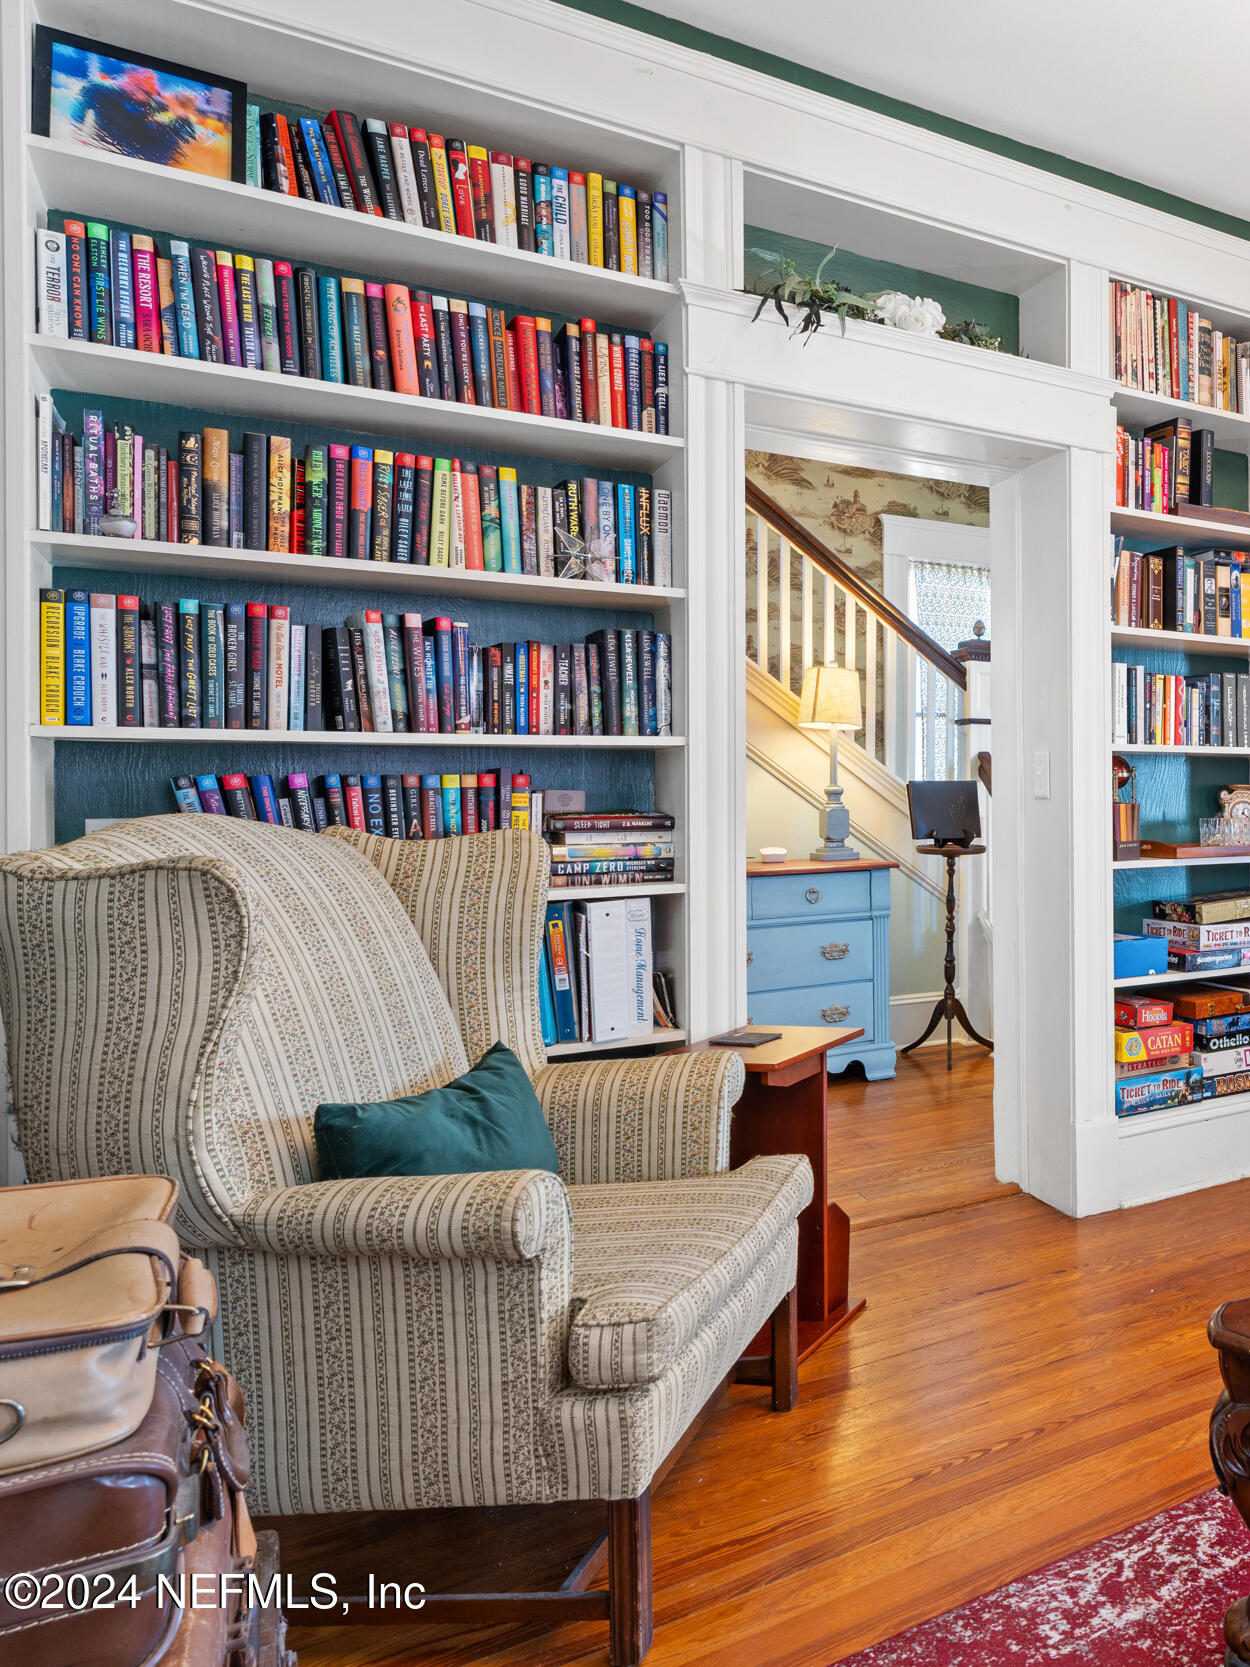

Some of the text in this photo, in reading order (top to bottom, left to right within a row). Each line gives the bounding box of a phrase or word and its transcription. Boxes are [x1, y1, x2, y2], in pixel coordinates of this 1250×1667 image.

[375, 136, 391, 180] JANE HARPER
[419, 168, 429, 193] Letters
[554, 195, 567, 225] CHILD
[99, 240, 107, 269] ASHLEY
[137, 253, 150, 271] THE
[71, 237, 83, 328] NO ONE CAN KNOW
[118, 253, 130, 290] HELSINKI
[177, 256, 189, 284] WHEN
[46, 266, 61, 302] TERROR
[138, 272, 153, 310] RESORT
[326, 283, 335, 300] THE
[96, 271, 106, 340] FIRST LIE WINS
[119, 291, 131, 319] AFFAIR
[240, 273, 253, 322] THE LAST WORD
[180, 303, 192, 329] DEAD
[327, 301, 337, 323] SONG
[493, 313, 502, 337] CIRCE
[244, 327, 255, 349] TAYLOR
[419, 313, 431, 357] LAST PARTY
[329, 337, 338, 377] ACHILLES
[458, 313, 466, 330] ONLY
[462, 362, 470, 384] LUCKY
[658, 365, 666, 382] LIES
[89, 414, 98, 501] RITUAL BATHS
[335, 460, 345, 477] LOCK
[335, 479, 345, 500] EVERY
[567, 483, 578, 509] RUTH
[601, 486, 611, 508] ONE
[377, 489, 390, 518] SAGER
[639, 487, 651, 536] INFLUX
[397, 518, 409, 560] RILEY SAGER
[123, 614, 136, 654] THE SHADOWS
[208, 619, 216, 635] BOOK
[73, 605, 86, 707] UPGRADE BLAKE CROUCH
[208, 643, 216, 658] COLD
[228, 624, 237, 672] BROKEN GIRLS
[252, 620, 263, 670] MURDER ROAD
[607, 634, 617, 681] LISA JEWELL
[643, 635, 651, 679] LISA JEWELL
[46, 605, 60, 713] RECURSION BLAKE CROUCH
[208, 658, 217, 677] CASES
[412, 646, 424, 678] WIVES
[425, 652, 433, 679] HONEST
[624, 634, 633, 686] LISA JEWELL
[275, 663, 283, 689] MOTEL
[504, 662, 513, 685] INMATE
[558, 660, 568, 686] TEACHER
[125, 667, 135, 709] ALEX NORTH
[235, 790, 245, 809] PRETTY
[297, 789, 311, 827] NECESSARY
[368, 793, 382, 814] NO
[389, 789, 398, 812] BEHIND
[409, 789, 418, 808] GIRL
[428, 790, 436, 813] MIRACLE
[466, 789, 475, 814] MATTHEW
[390, 813, 399, 826] HER
[574, 820, 610, 829] SLEEP TIGHT
[558, 861, 624, 875] CAMP ZERO
[601, 872, 643, 885] WOMEN
[1205, 927, 1234, 942] TICKET
[631, 926, 649, 1024] Home Management
[1142, 1010, 1168, 1024] Hoopla
[1147, 1033, 1182, 1050] CATAN
[1209, 1033, 1250, 1050] Othello
[1127, 1057, 1168, 1072] STRATEGO
[1120, 1078, 1182, 1100] TICKET TO RIDE
